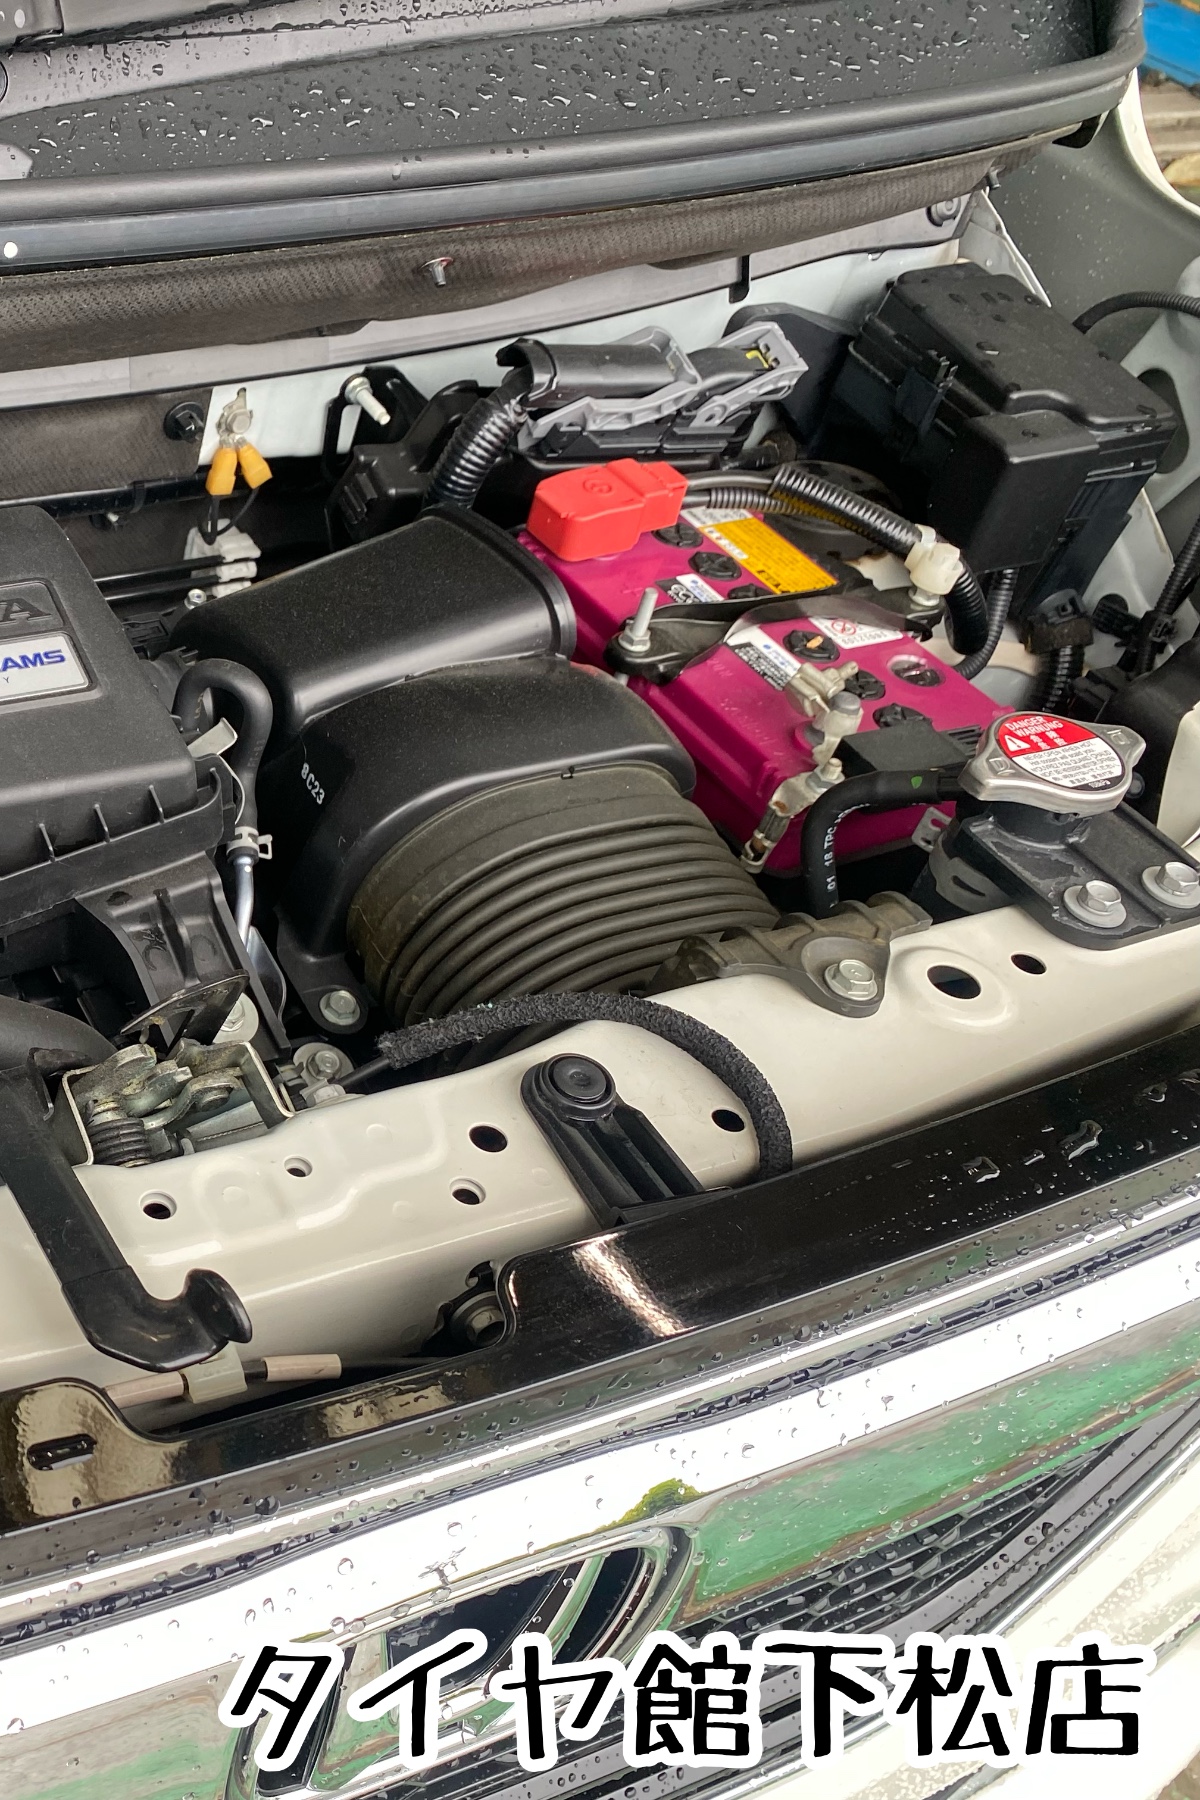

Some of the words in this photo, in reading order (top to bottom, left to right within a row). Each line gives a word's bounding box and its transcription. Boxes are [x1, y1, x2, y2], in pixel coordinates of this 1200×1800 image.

[1005, 716, 1047, 730] DANGER
[1013, 720, 1064, 737] WARNUNG
[300, 762, 326, 805] 8C23
